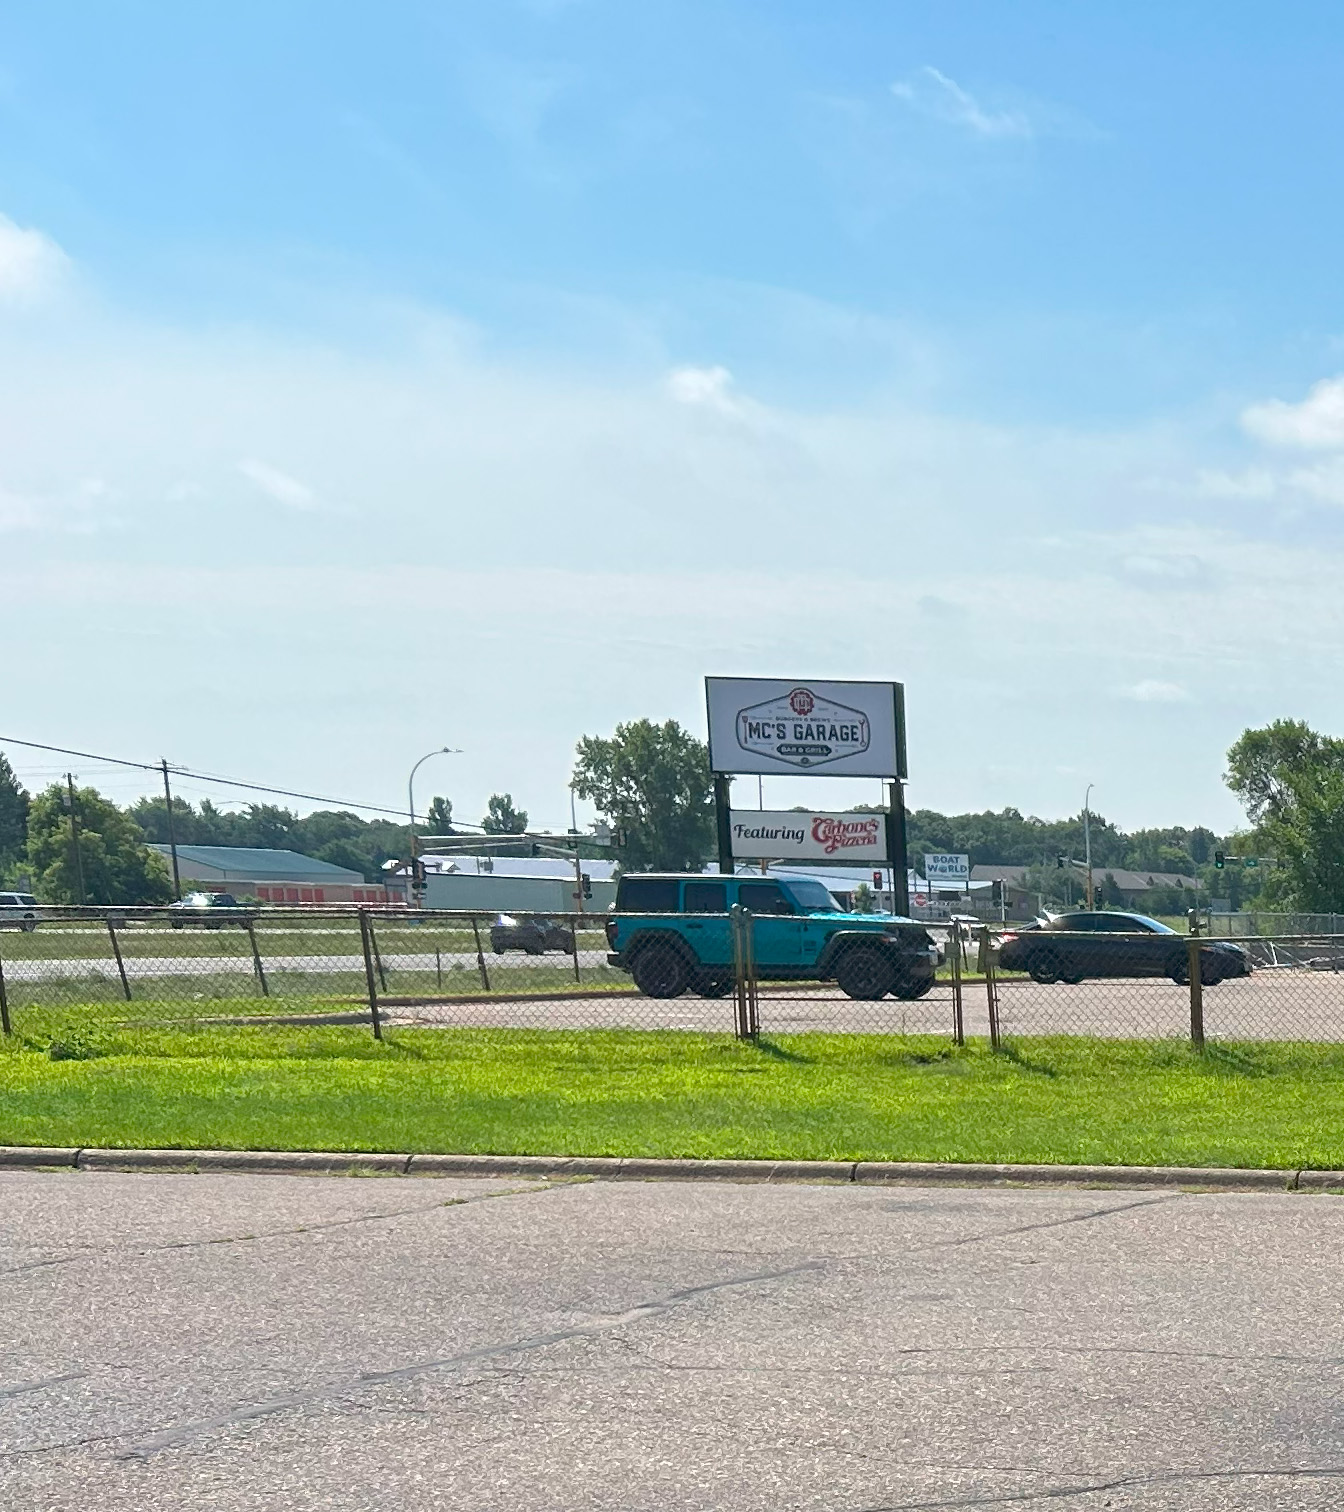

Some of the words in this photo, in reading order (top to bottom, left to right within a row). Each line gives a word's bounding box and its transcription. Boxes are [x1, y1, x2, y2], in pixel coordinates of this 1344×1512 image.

[748, 722, 786, 740] MC'S
[794, 723, 859, 742] GARAGE
[733, 824, 805, 844] Featuring
[933, 856, 960, 864] BOAT
